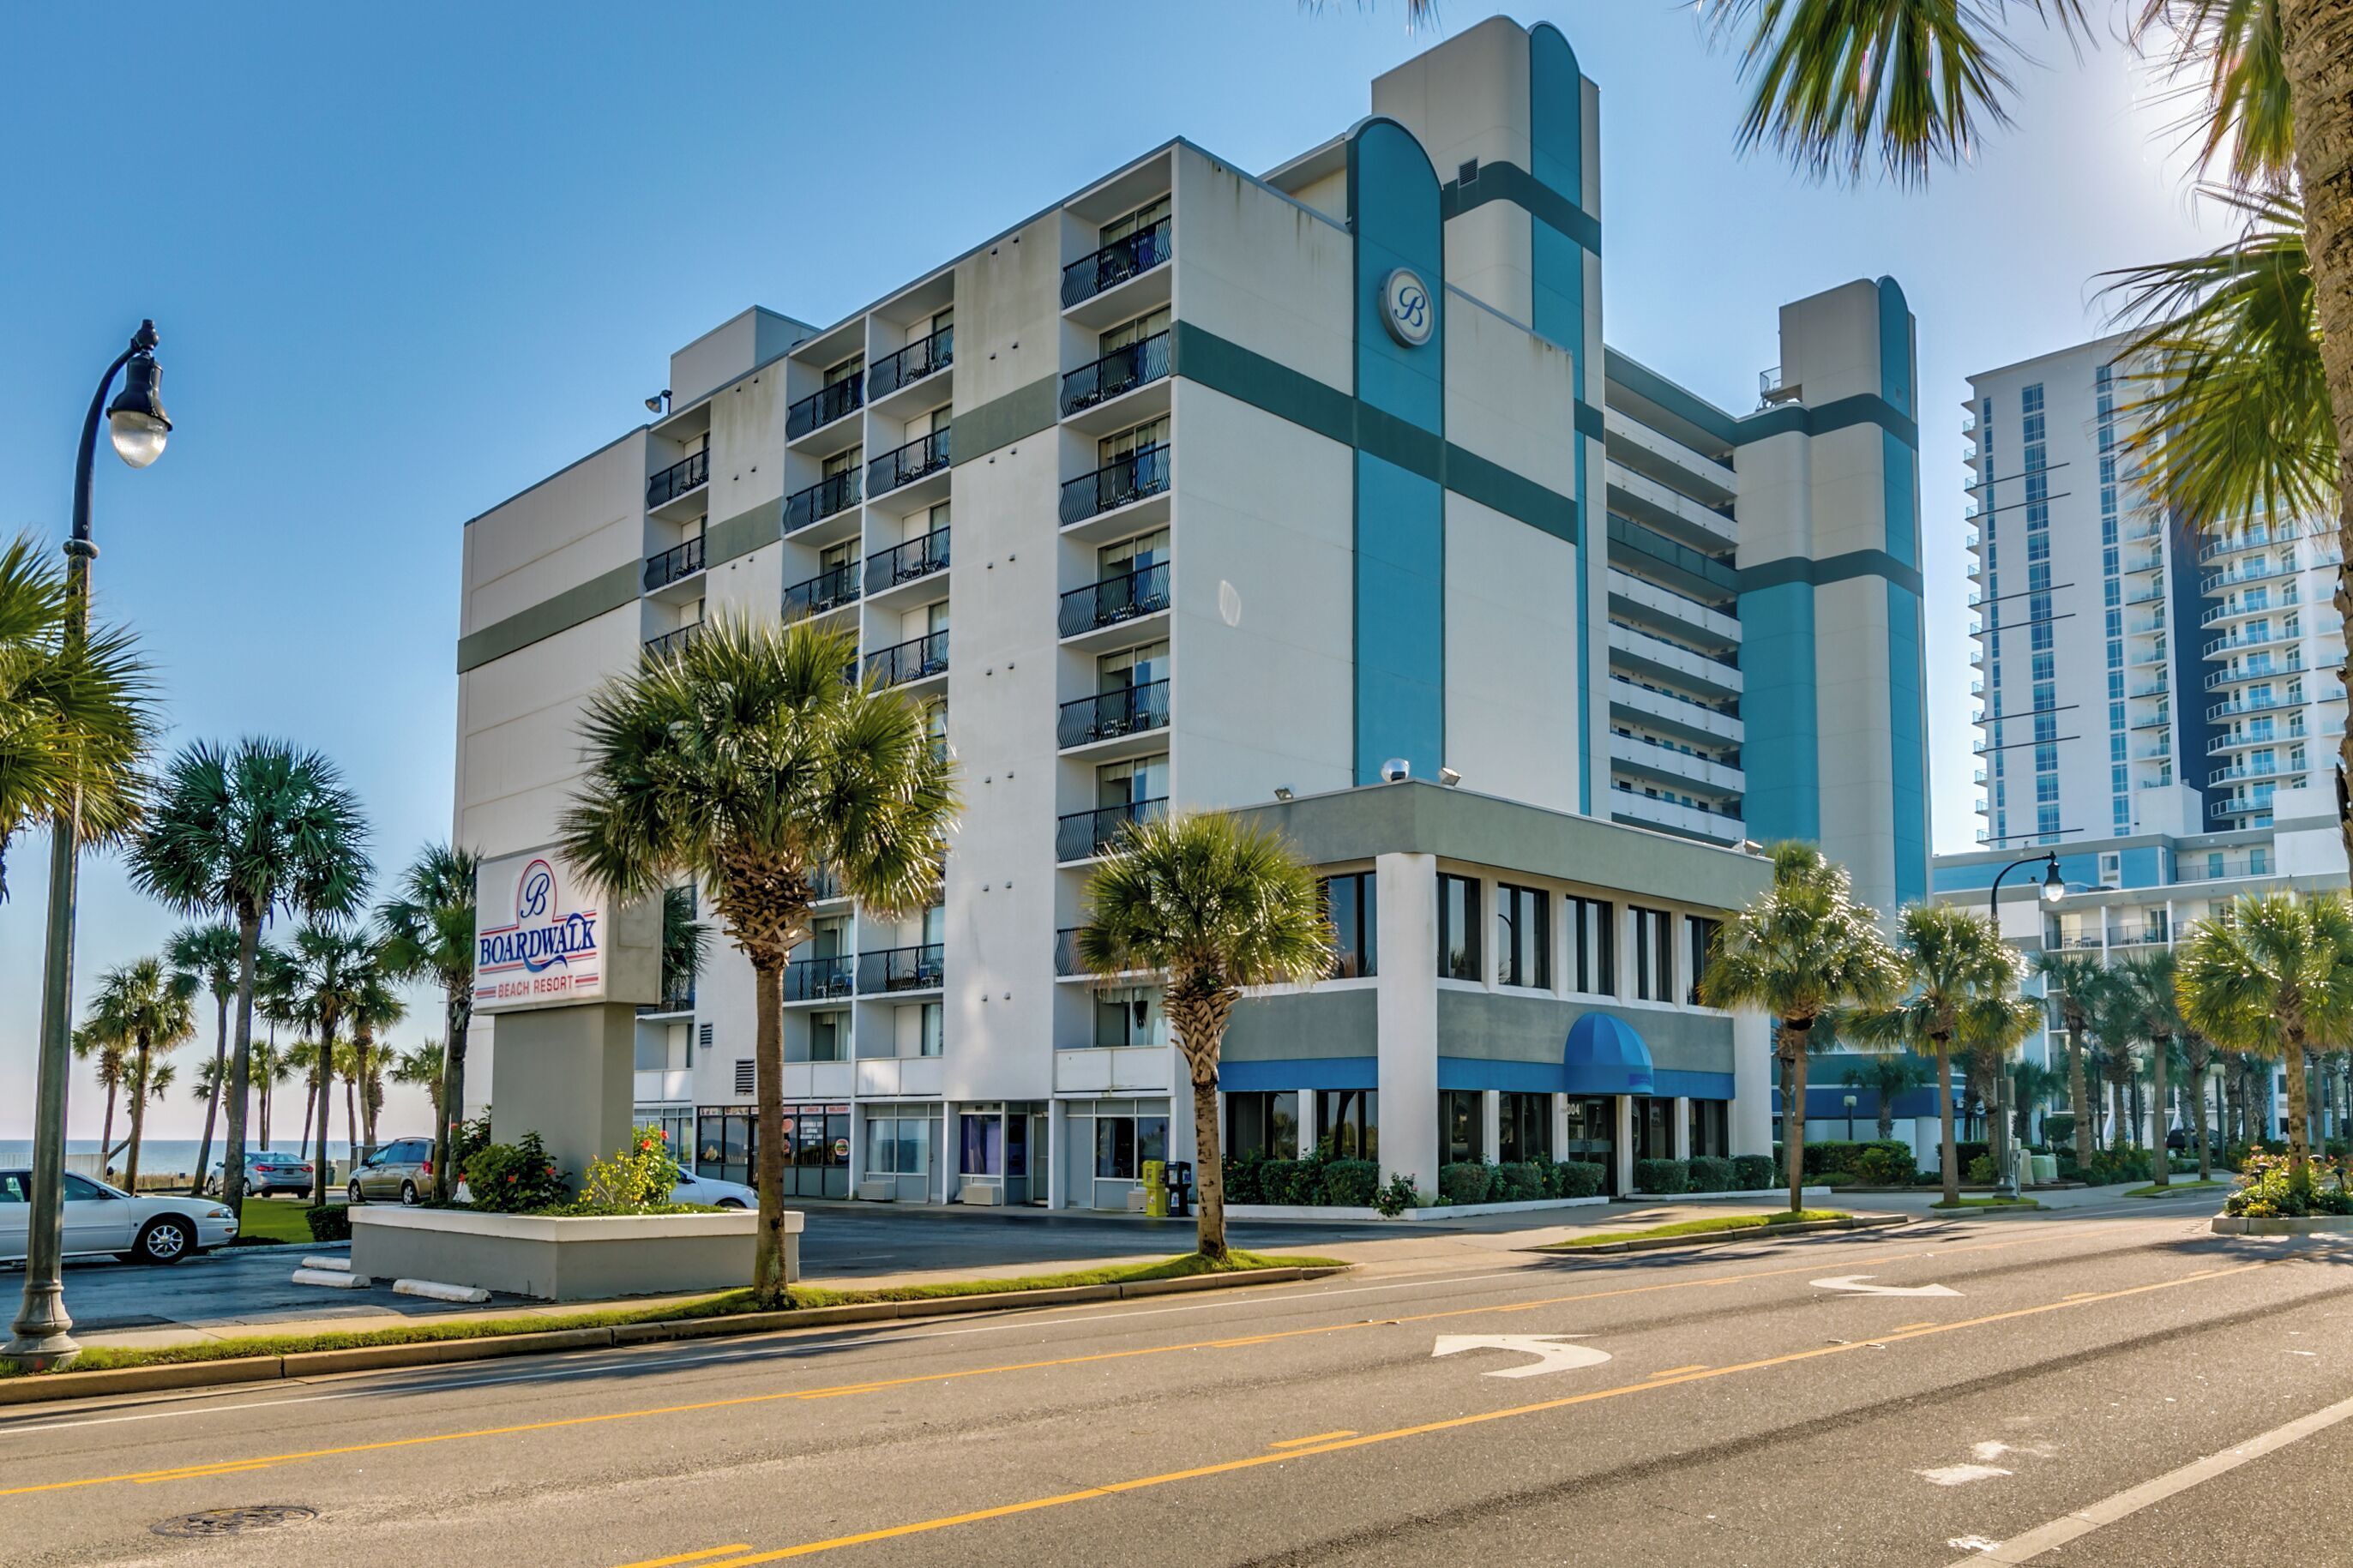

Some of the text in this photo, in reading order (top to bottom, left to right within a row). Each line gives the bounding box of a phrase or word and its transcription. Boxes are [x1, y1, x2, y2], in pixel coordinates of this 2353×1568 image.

[1394, 286, 1426, 327] B
[520, 873, 551, 918] B
[478, 914, 596, 972] BOARDWALK
[497, 975, 574, 1000] BEACH RESORT
